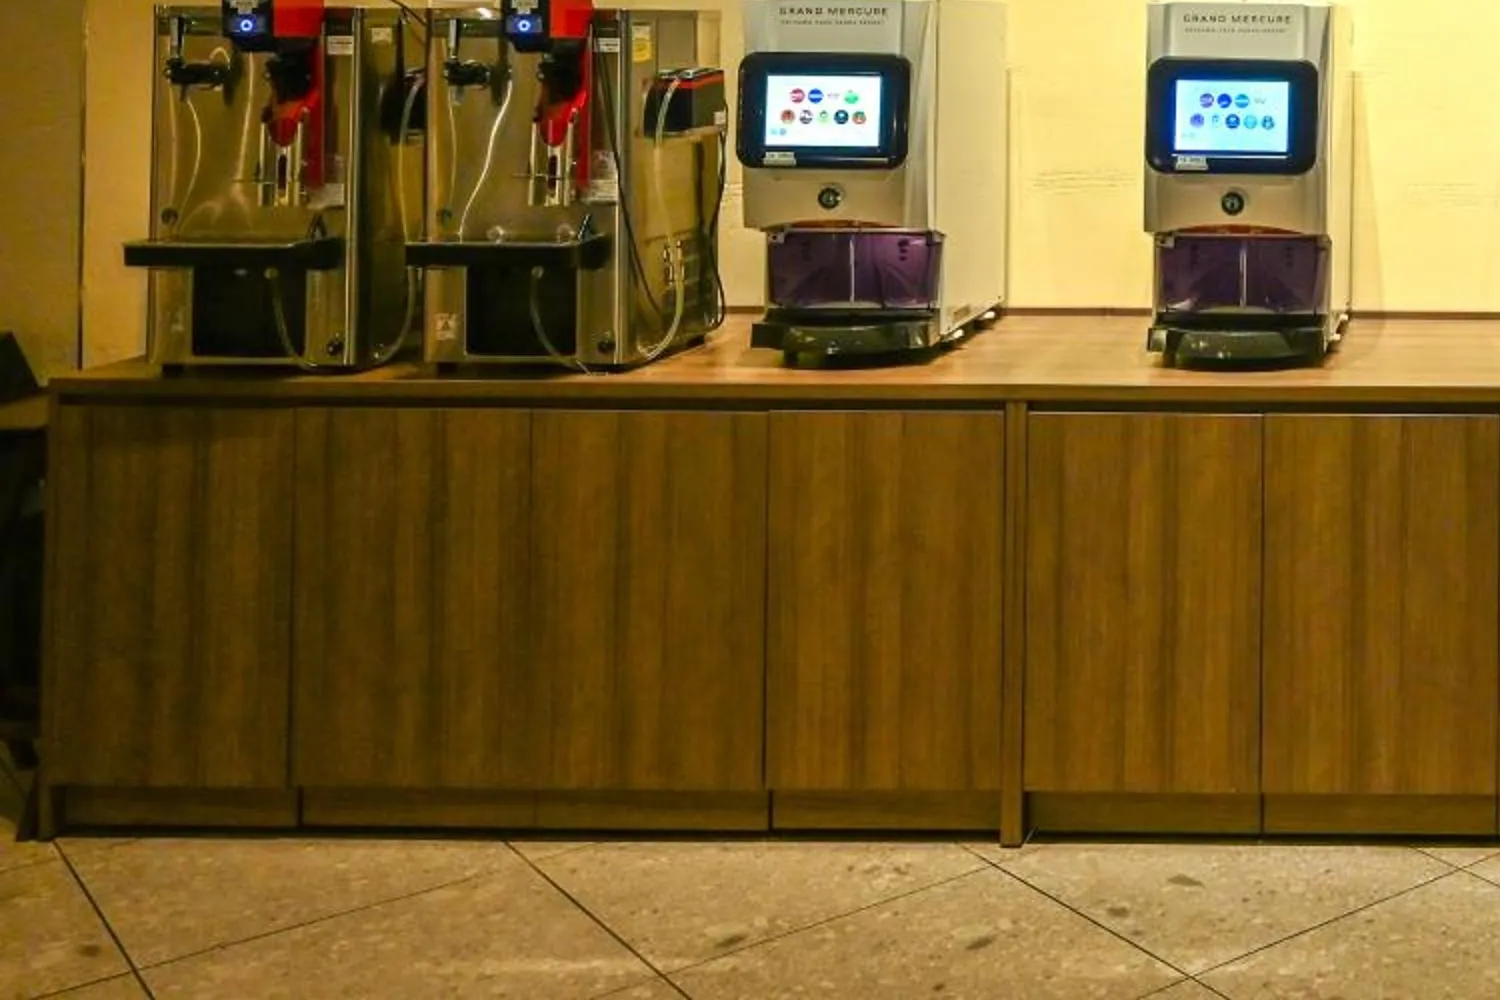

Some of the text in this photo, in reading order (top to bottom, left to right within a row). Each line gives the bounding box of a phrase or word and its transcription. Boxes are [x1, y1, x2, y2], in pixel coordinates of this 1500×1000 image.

[778, 6, 887, 17] GRAND MERCURE
[1183, 14, 1291, 24] GRAND MERCURE
